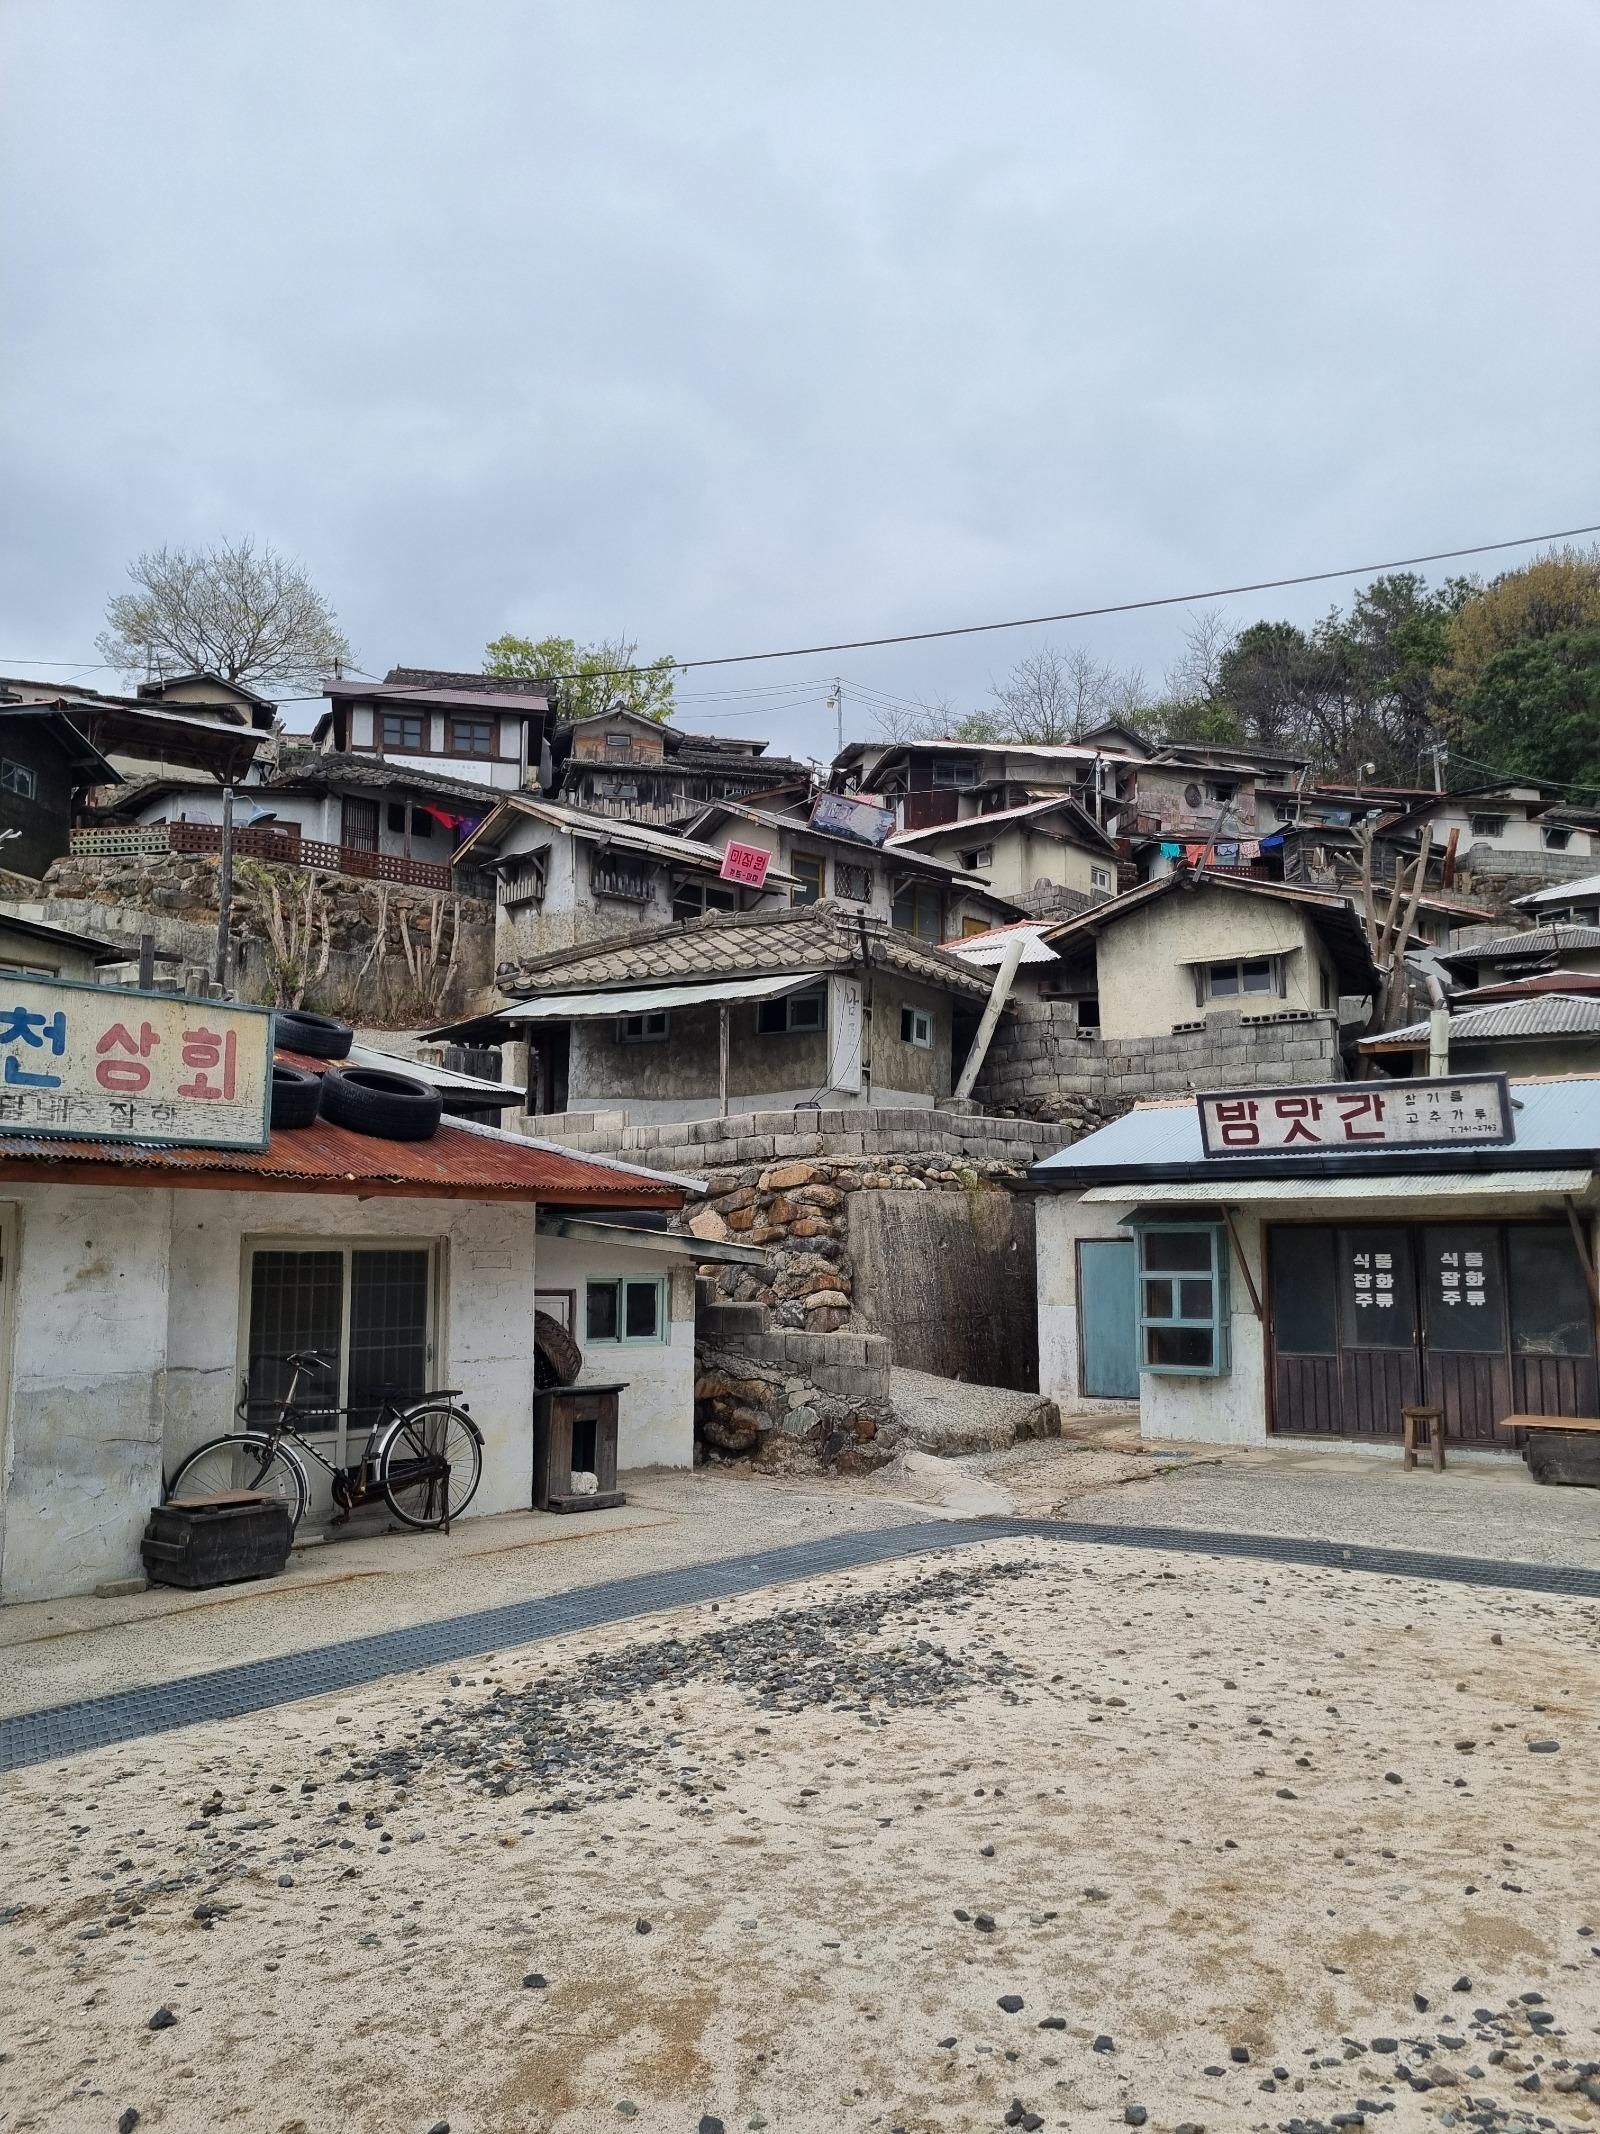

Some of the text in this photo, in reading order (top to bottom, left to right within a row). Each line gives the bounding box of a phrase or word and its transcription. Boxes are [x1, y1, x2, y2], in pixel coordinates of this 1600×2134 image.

[730, 849, 767, 871] 미장원
[95, 1021, 237, 1100] 상회
[1405, 1088, 1463, 1106] 참기름
[1215, 1094, 1386, 1145] 방앗간
[1406, 1109, 1487, 1124] 고추가루
[1353, 1253, 1393, 1269] 식품
[1440, 1252, 1483, 1267] 식품
[1353, 1273, 1394, 1289] 잡화
[1440, 1270, 1486, 1287] 잡화
[1355, 1293, 1394, 1308] 주류
[1442, 1291, 1486, 1306] 주류
